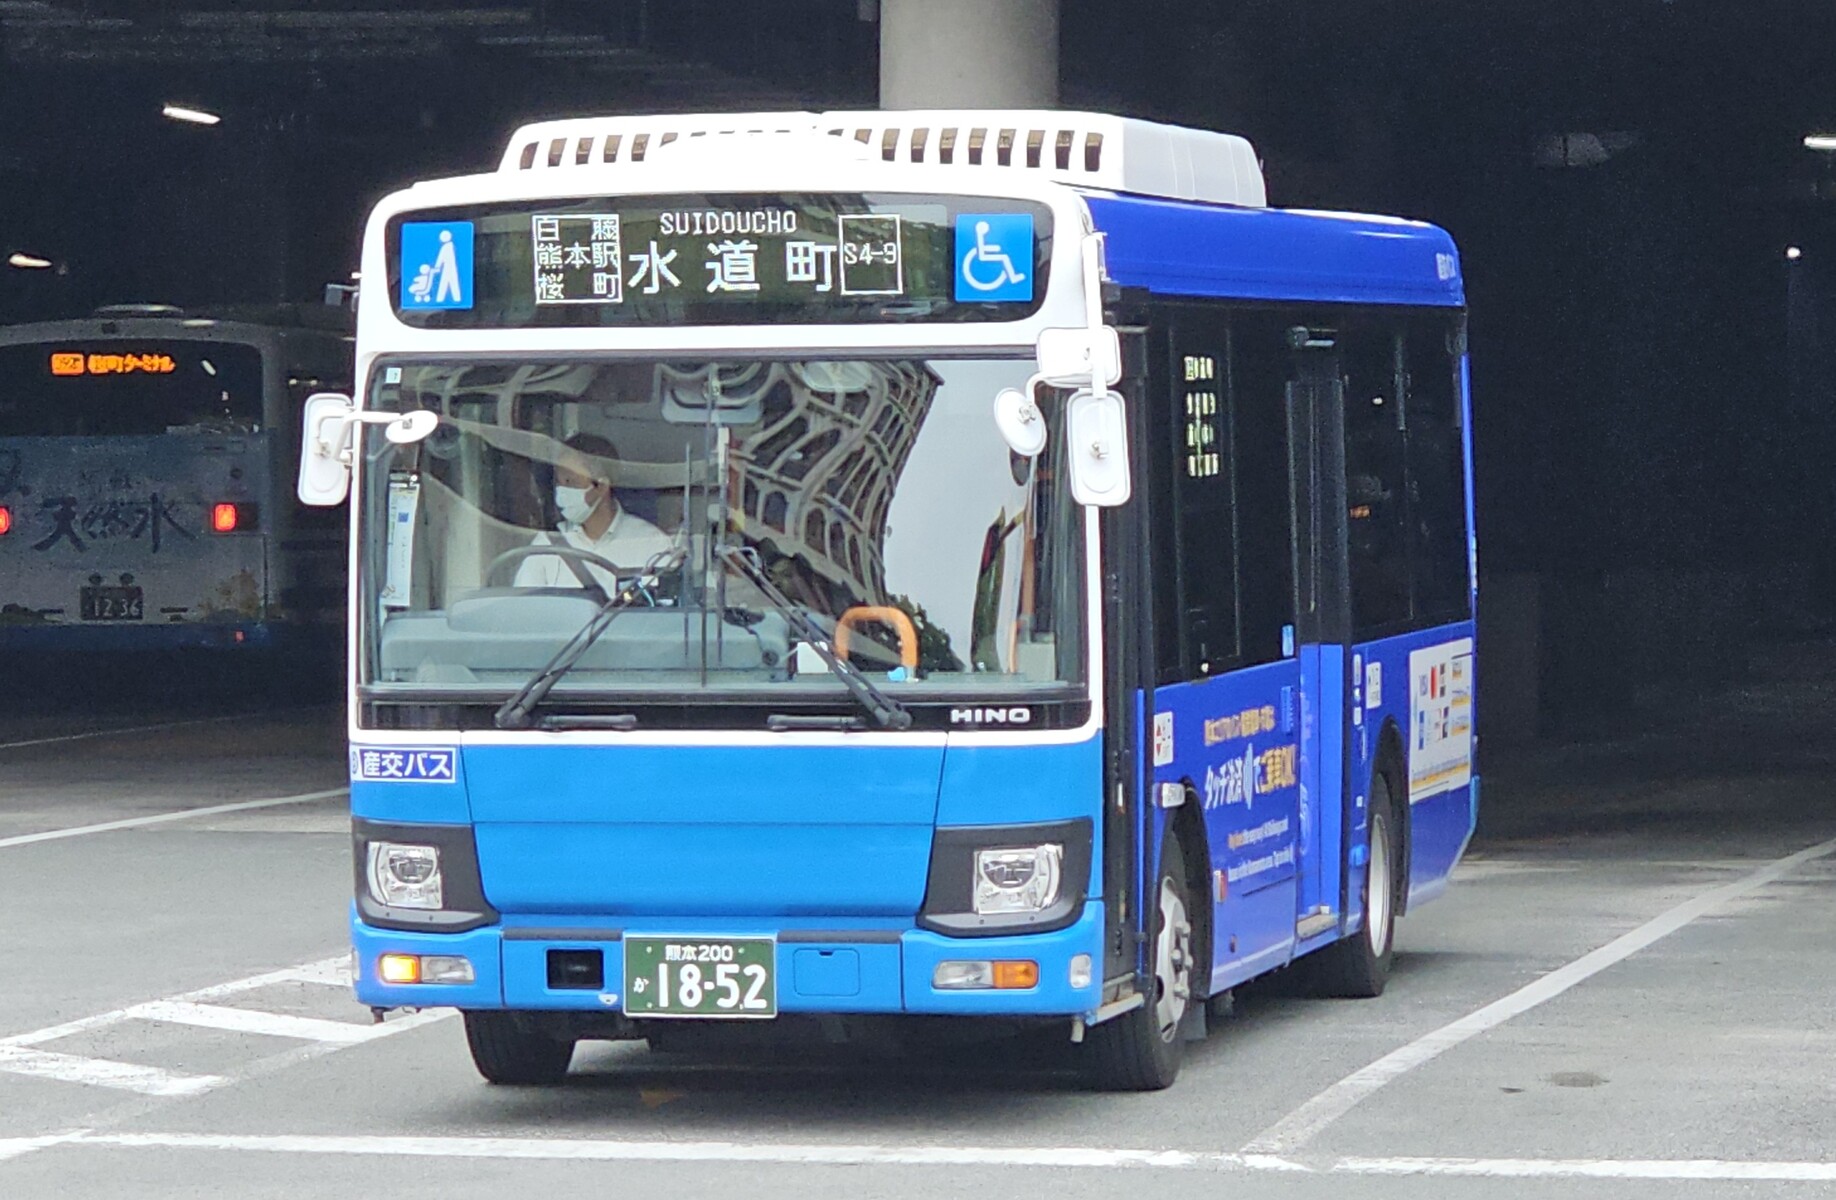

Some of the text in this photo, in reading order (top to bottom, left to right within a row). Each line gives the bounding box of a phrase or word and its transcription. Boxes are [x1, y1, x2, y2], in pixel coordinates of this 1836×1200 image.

[660, 212, 797, 235] SUIDOUCHO
[538, 243, 619, 269] 熊本駅
[844, 242, 897, 265] S4-9
[628, 240, 838, 294] 水道町
[950, 708, 1030, 723] HINO
[363, 752, 451, 777] 産交バス
[658, 963, 767, 1009] 18-52
